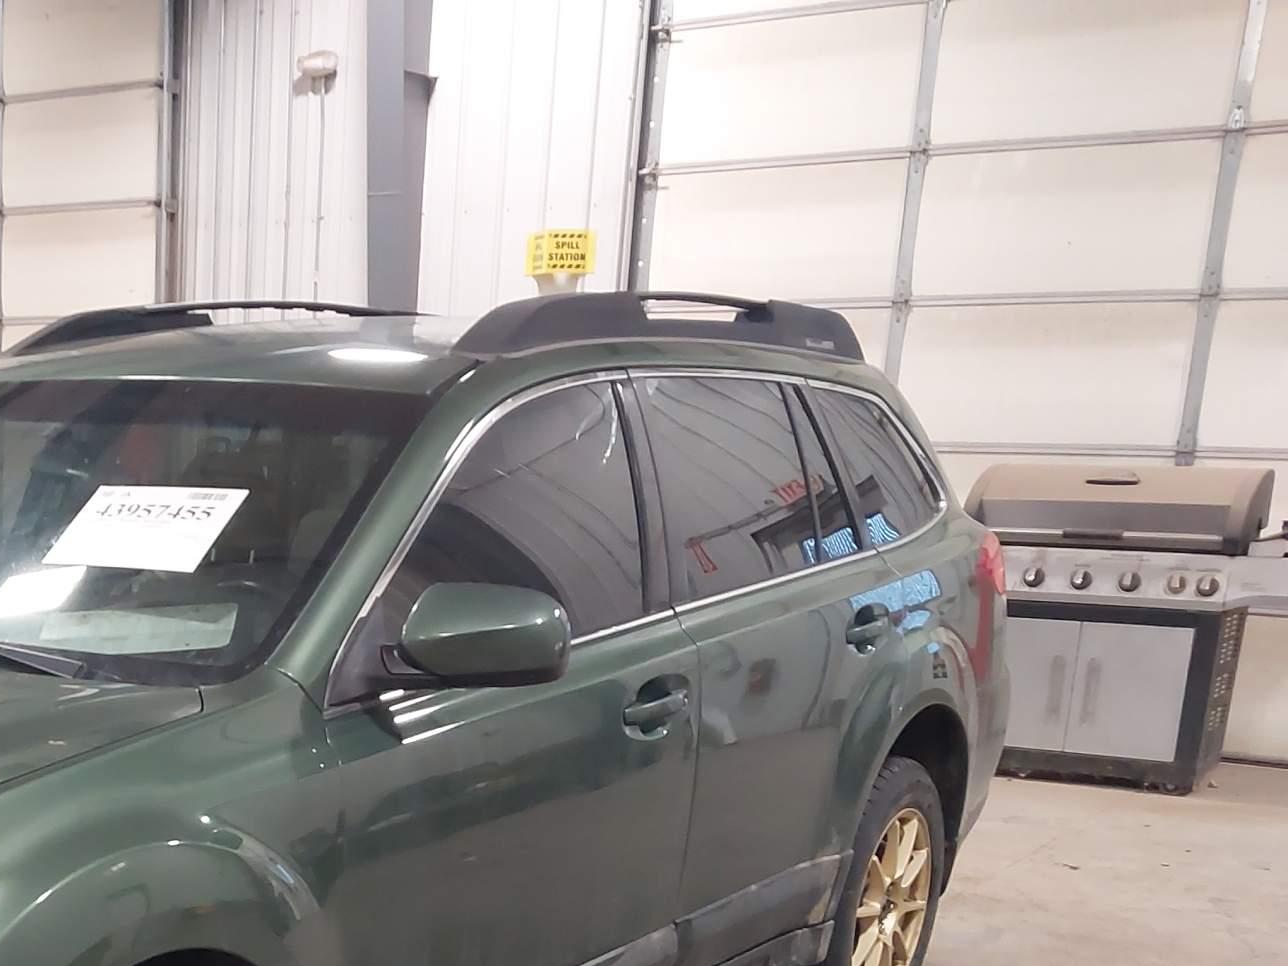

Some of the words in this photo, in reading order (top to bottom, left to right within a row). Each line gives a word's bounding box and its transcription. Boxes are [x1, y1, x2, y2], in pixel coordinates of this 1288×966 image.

[555, 241, 580, 249] SPILL
[548, 253, 586, 262] STATION
[96, 503, 216, 520] 43957455
